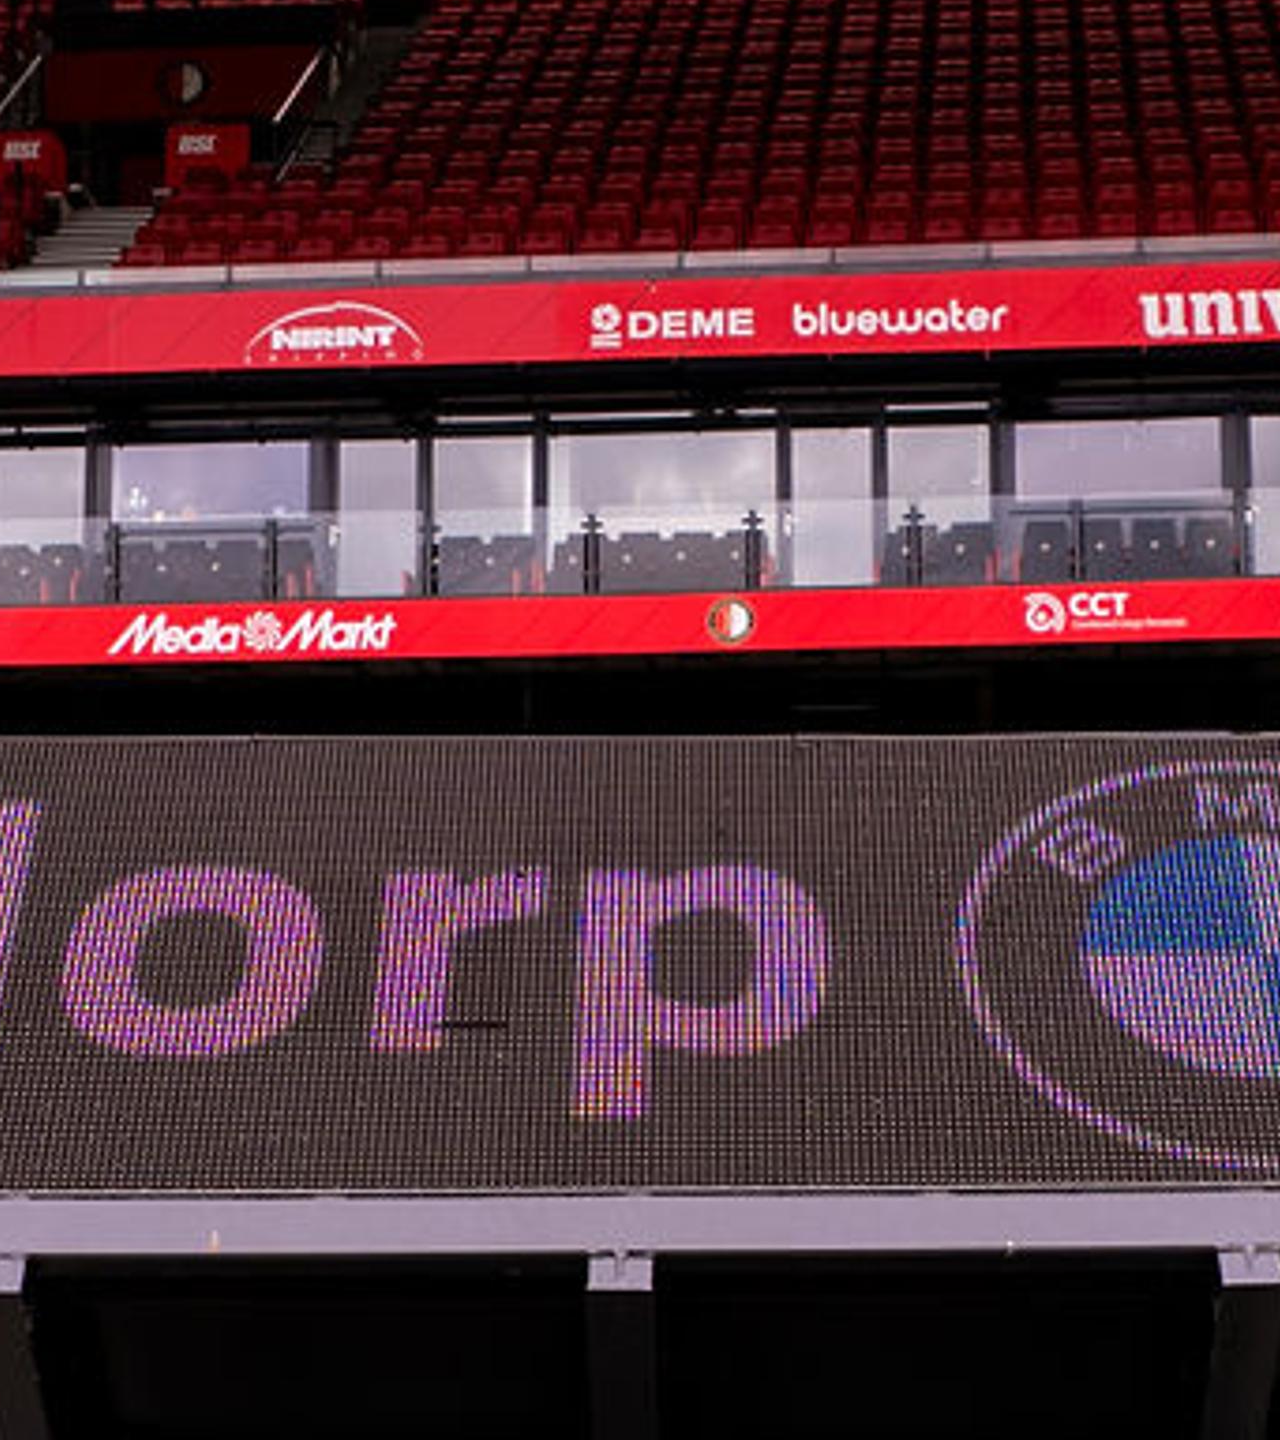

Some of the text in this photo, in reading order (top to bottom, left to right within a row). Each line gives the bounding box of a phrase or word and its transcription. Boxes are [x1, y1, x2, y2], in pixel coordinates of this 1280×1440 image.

[628, 307, 755, 339] DEME
[792, 300, 1009, 336] bluewater
[271, 324, 397, 351] NIRINT
[1068, 591, 1129, 617] CCT
